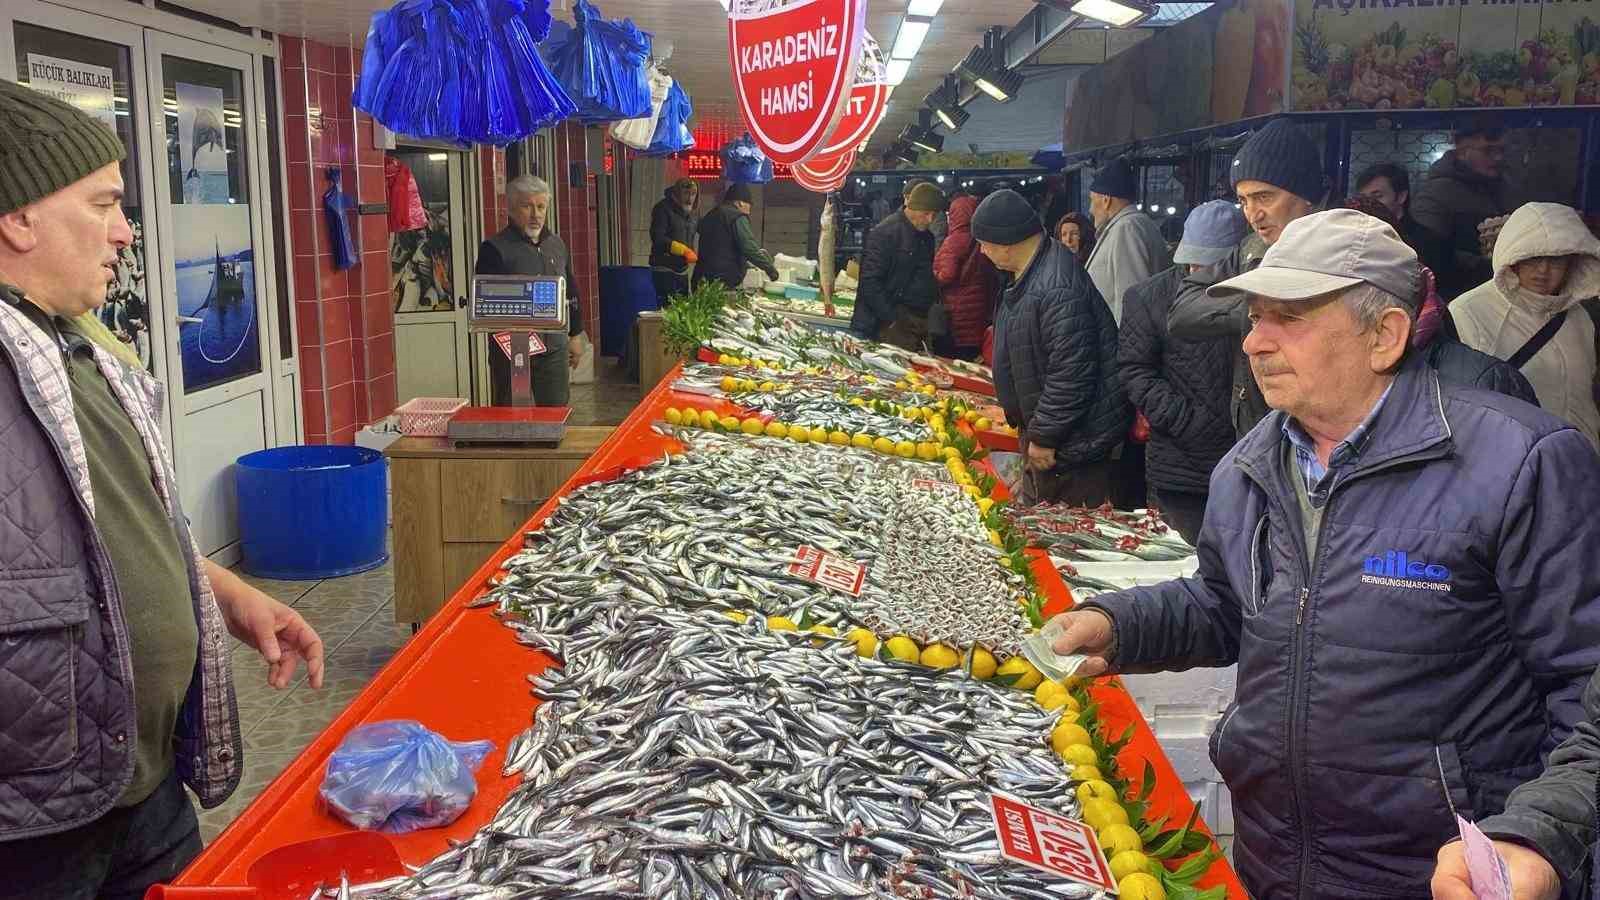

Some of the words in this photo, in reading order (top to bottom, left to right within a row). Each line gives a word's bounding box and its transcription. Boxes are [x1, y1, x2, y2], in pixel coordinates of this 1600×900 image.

[741, 17, 838, 74] KARADENİZ
[31, 61, 64, 82] KÜÇÜK
[66, 69, 111, 89] BALIKLARI
[761, 70, 814, 116] HAMSİ
[1361, 575, 1451, 592] REINIGUNGSMASCHINEN
[1364, 549, 1450, 581] nilco
[1040, 830, 1099, 880] 250
